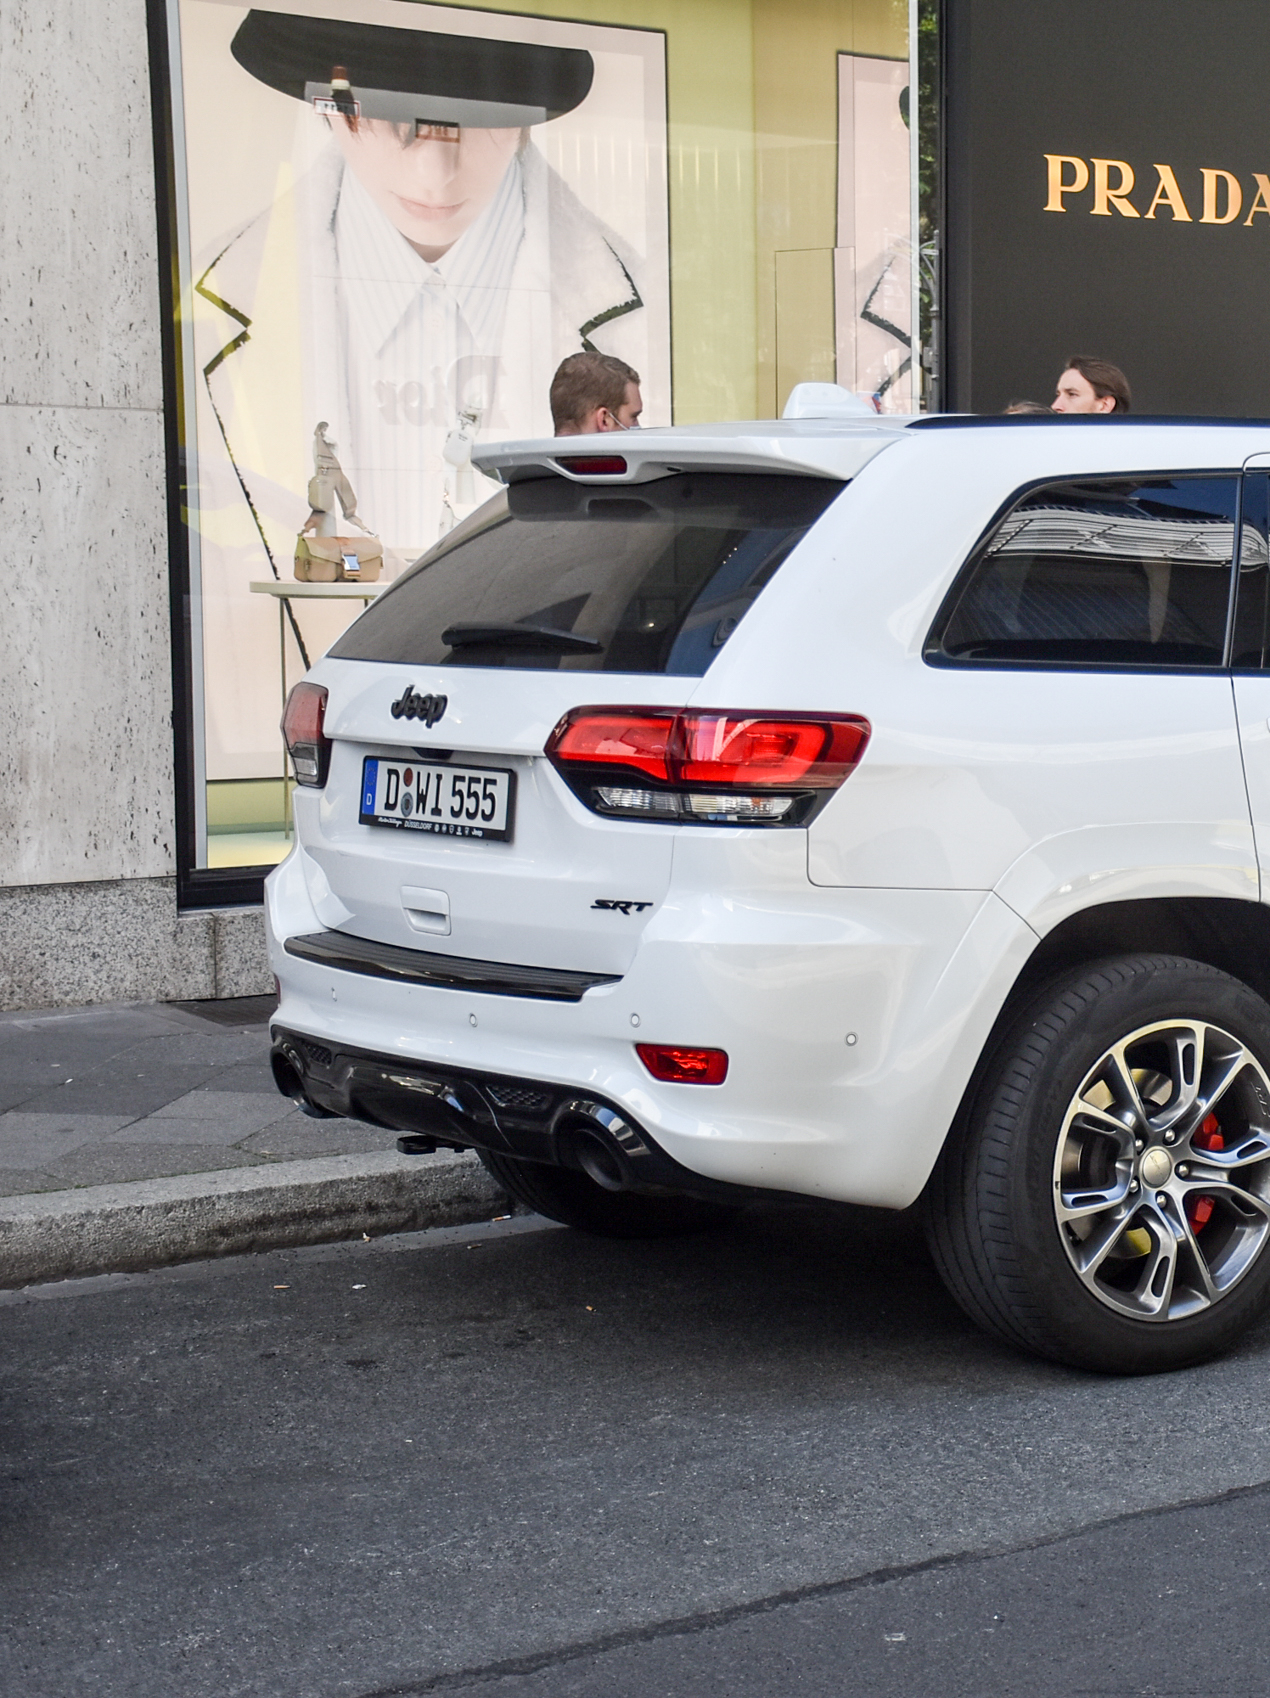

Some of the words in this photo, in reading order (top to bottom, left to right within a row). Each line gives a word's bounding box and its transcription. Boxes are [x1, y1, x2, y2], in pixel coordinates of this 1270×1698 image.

[391, 684, 448, 729] Jeep
[366, 793, 373, 805] D
[384, 768, 400, 811] D
[415, 771, 443, 816] WI
[450, 774, 498, 822] 555
[590, 899, 654, 915] SRT
